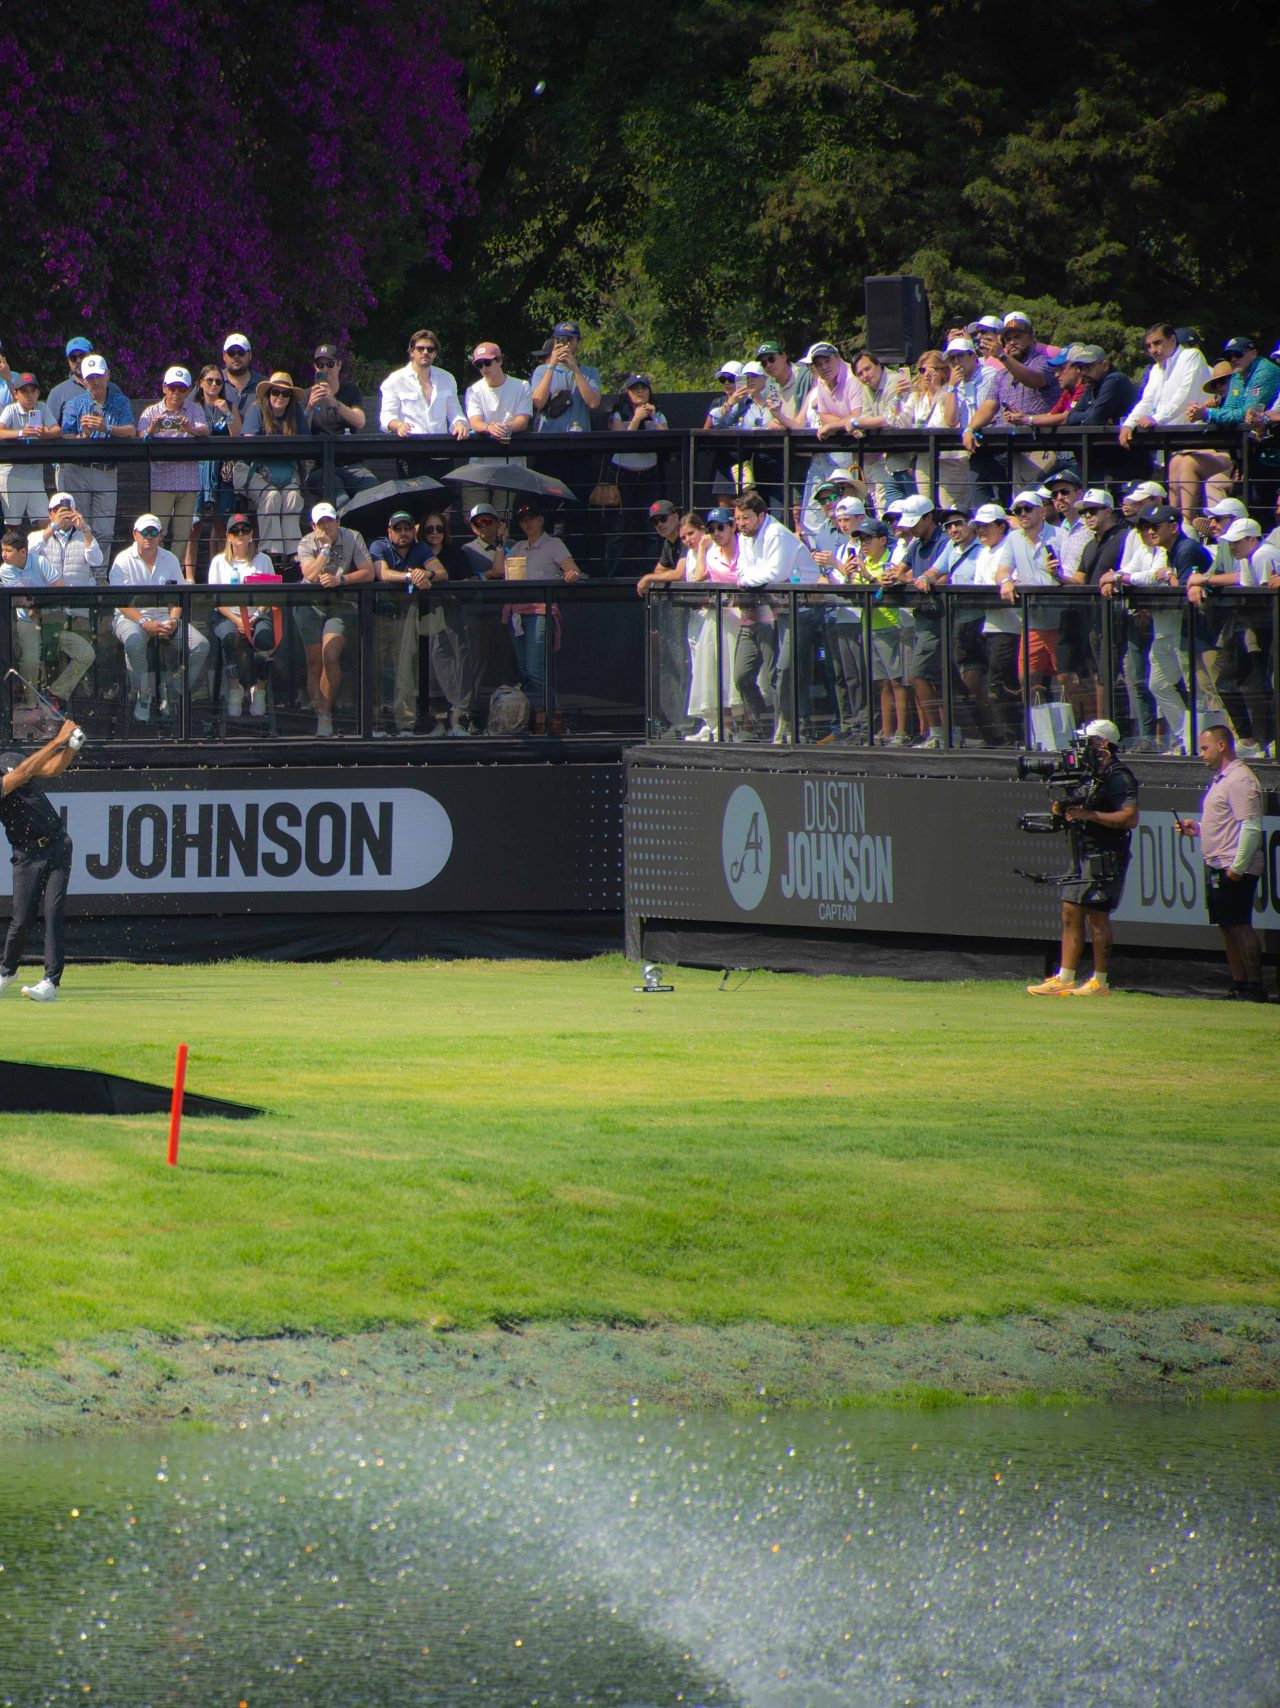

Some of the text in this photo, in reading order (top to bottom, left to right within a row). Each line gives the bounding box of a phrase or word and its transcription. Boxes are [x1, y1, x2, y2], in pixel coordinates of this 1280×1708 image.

[804, 780, 866, 833] DUSTIN
[85, 801, 394, 880] JOHNSON
[780, 831, 894, 904] JOHNSON
[818, 903, 857, 922] CAPTAIN
